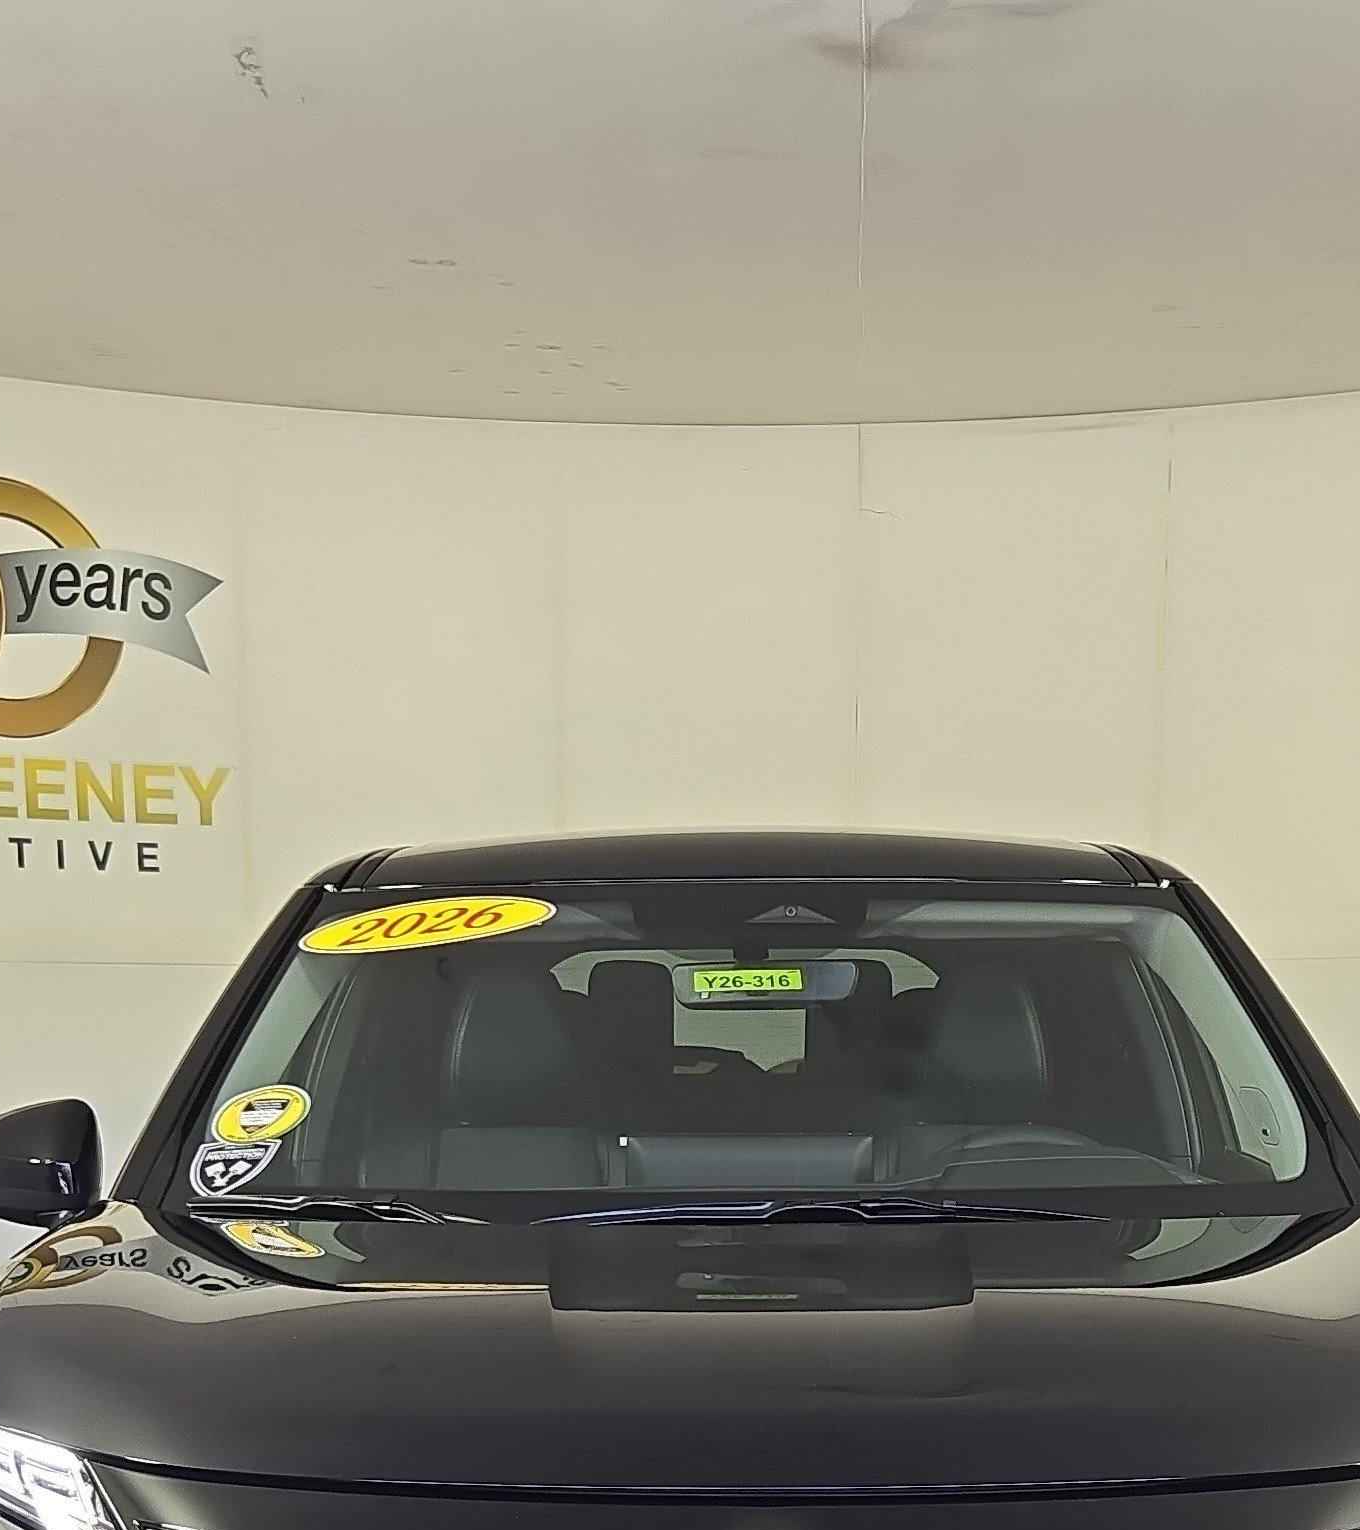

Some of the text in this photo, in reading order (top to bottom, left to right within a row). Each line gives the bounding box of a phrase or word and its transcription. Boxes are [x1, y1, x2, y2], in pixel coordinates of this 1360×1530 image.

[13, 557, 173, 624] years
[337, 902, 516, 947] 2026
[703, 975, 790, 989] Y26-316
